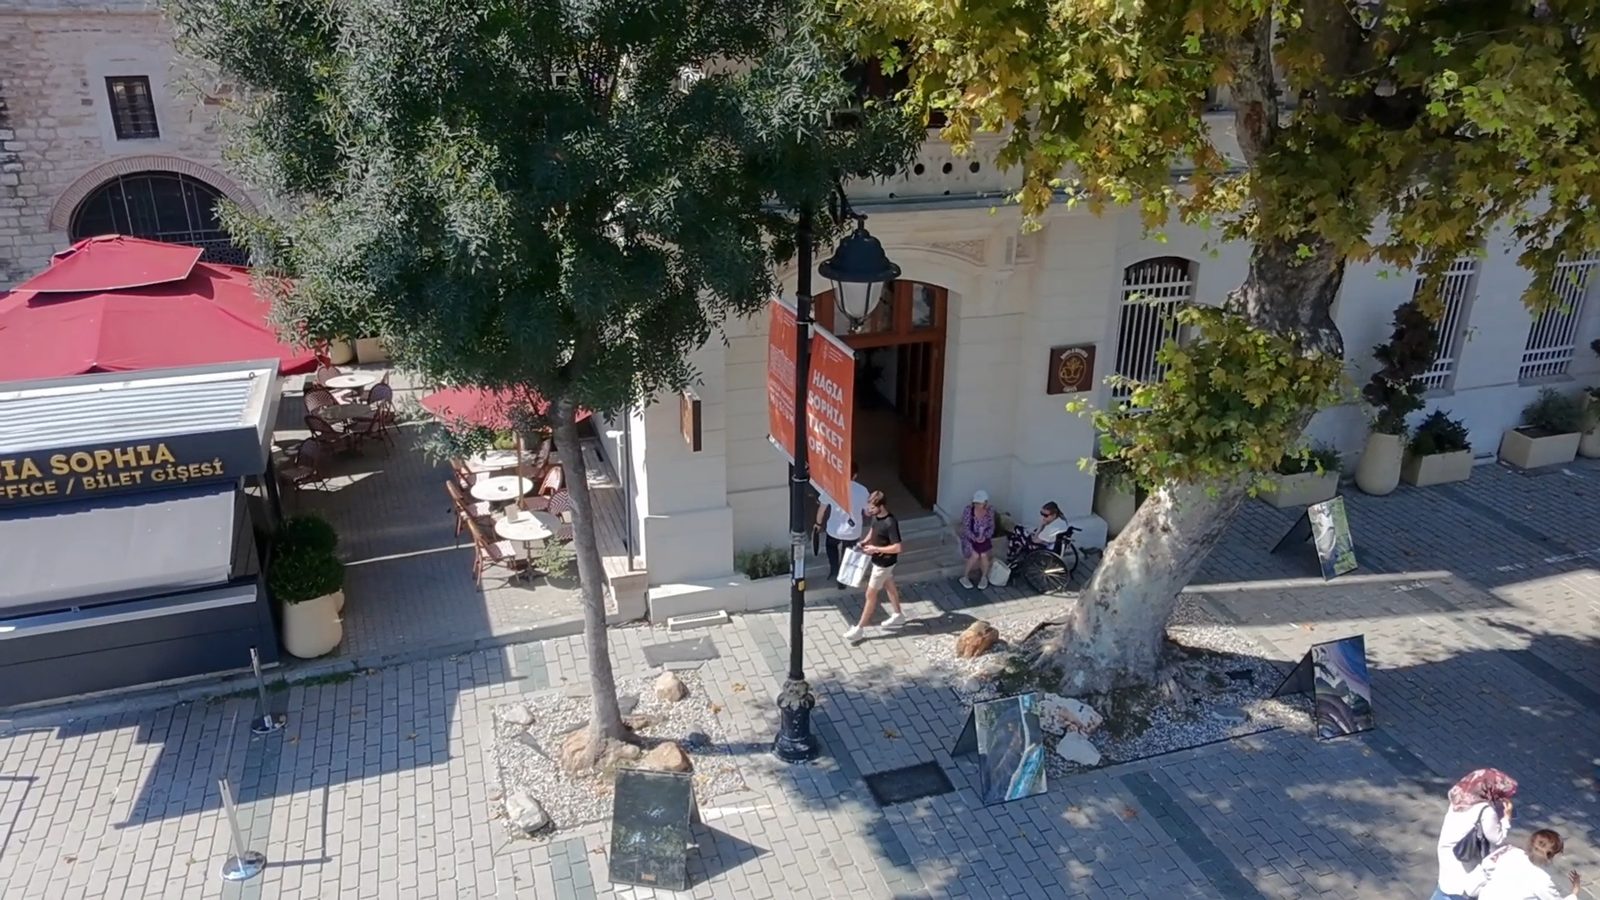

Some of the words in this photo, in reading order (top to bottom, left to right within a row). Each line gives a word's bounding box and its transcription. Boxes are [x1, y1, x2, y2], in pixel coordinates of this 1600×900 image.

[812, 369, 844, 404] HAGIA
[807, 390, 846, 431] SOPHIA
[807, 412, 845, 451] TICKET
[0, 457, 43, 481] IA
[50, 442, 176, 475] SOPHIA
[82, 471, 144, 491] BİLET
[150, 457, 224, 483] GİŞESİ
[808, 435, 844, 474] OFFICE
